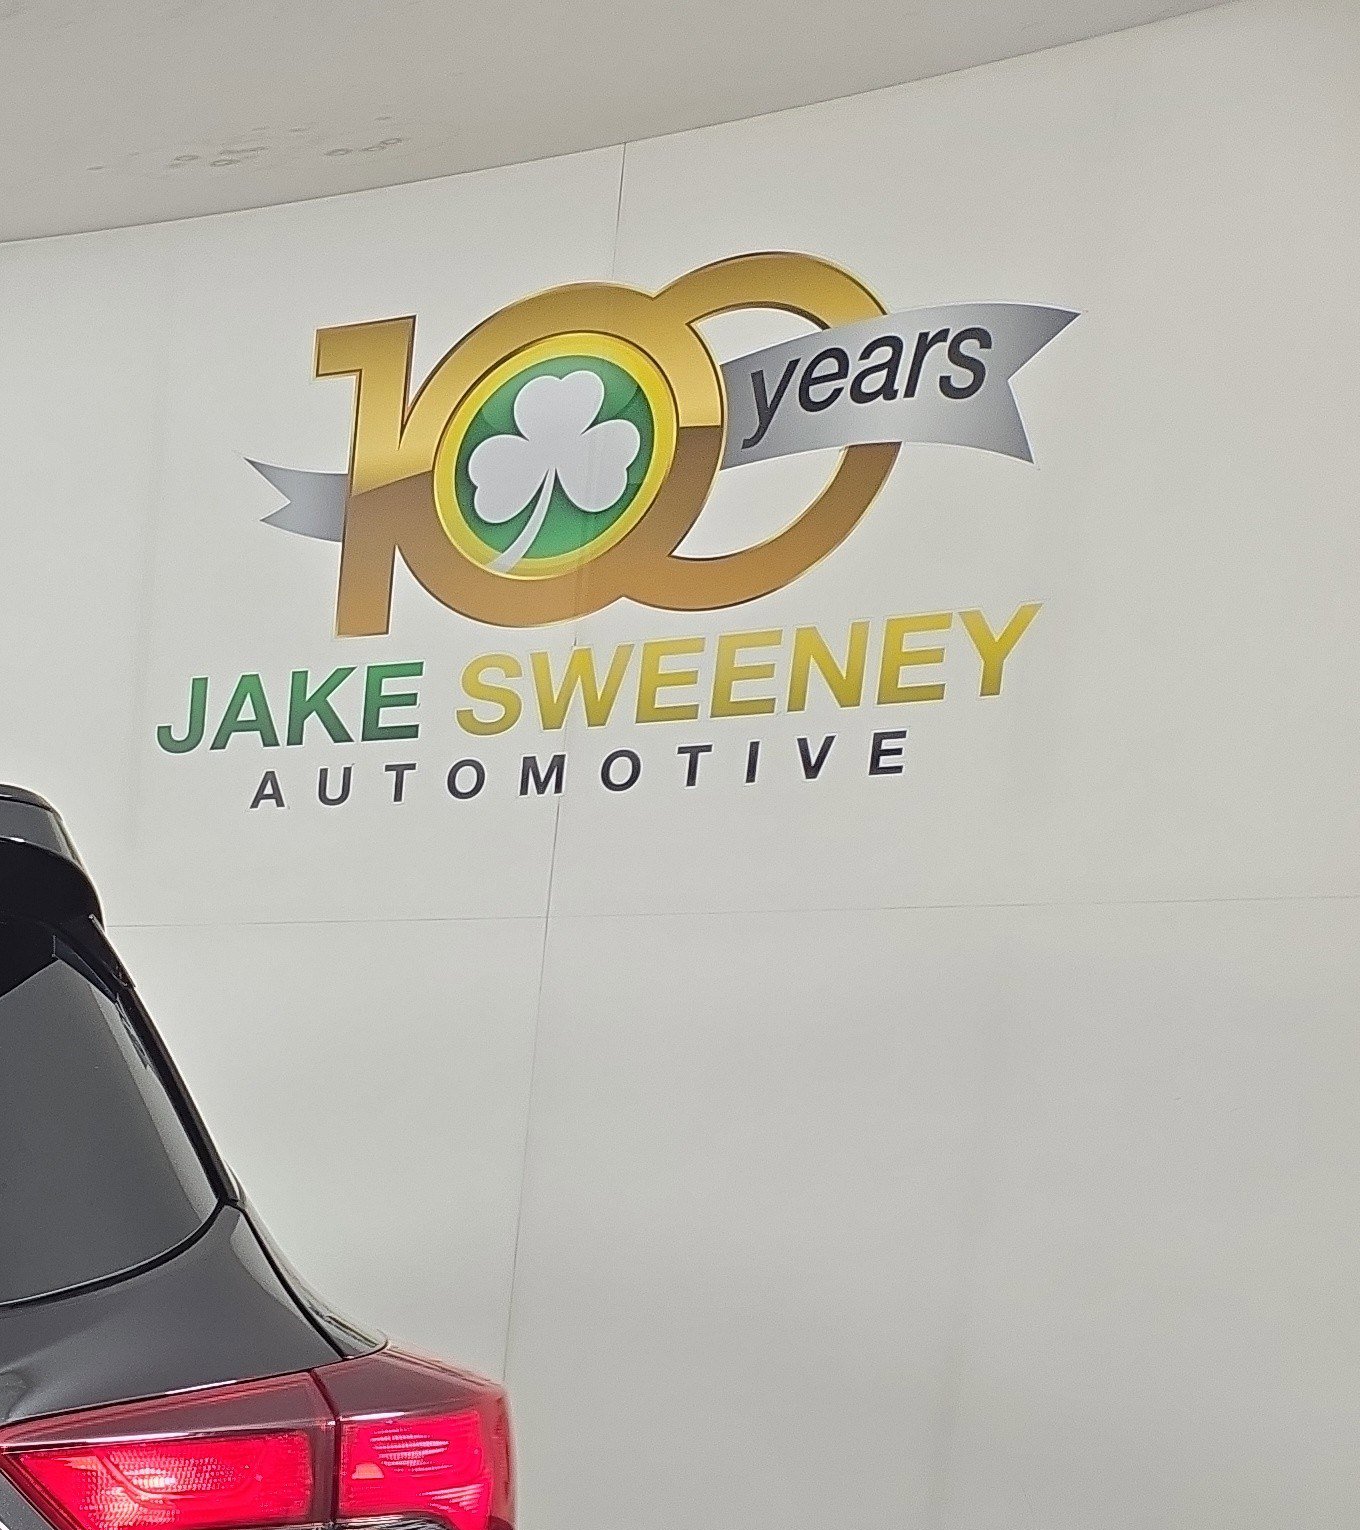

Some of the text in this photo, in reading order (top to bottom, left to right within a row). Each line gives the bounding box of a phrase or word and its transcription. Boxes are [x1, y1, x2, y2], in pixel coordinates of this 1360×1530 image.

[313, 250, 904, 639] 100
[740, 324, 994, 450] years
[156, 603, 1044, 756] JAKE SWEENEY
[249, 730, 908, 810] AUTOMOTIVE
